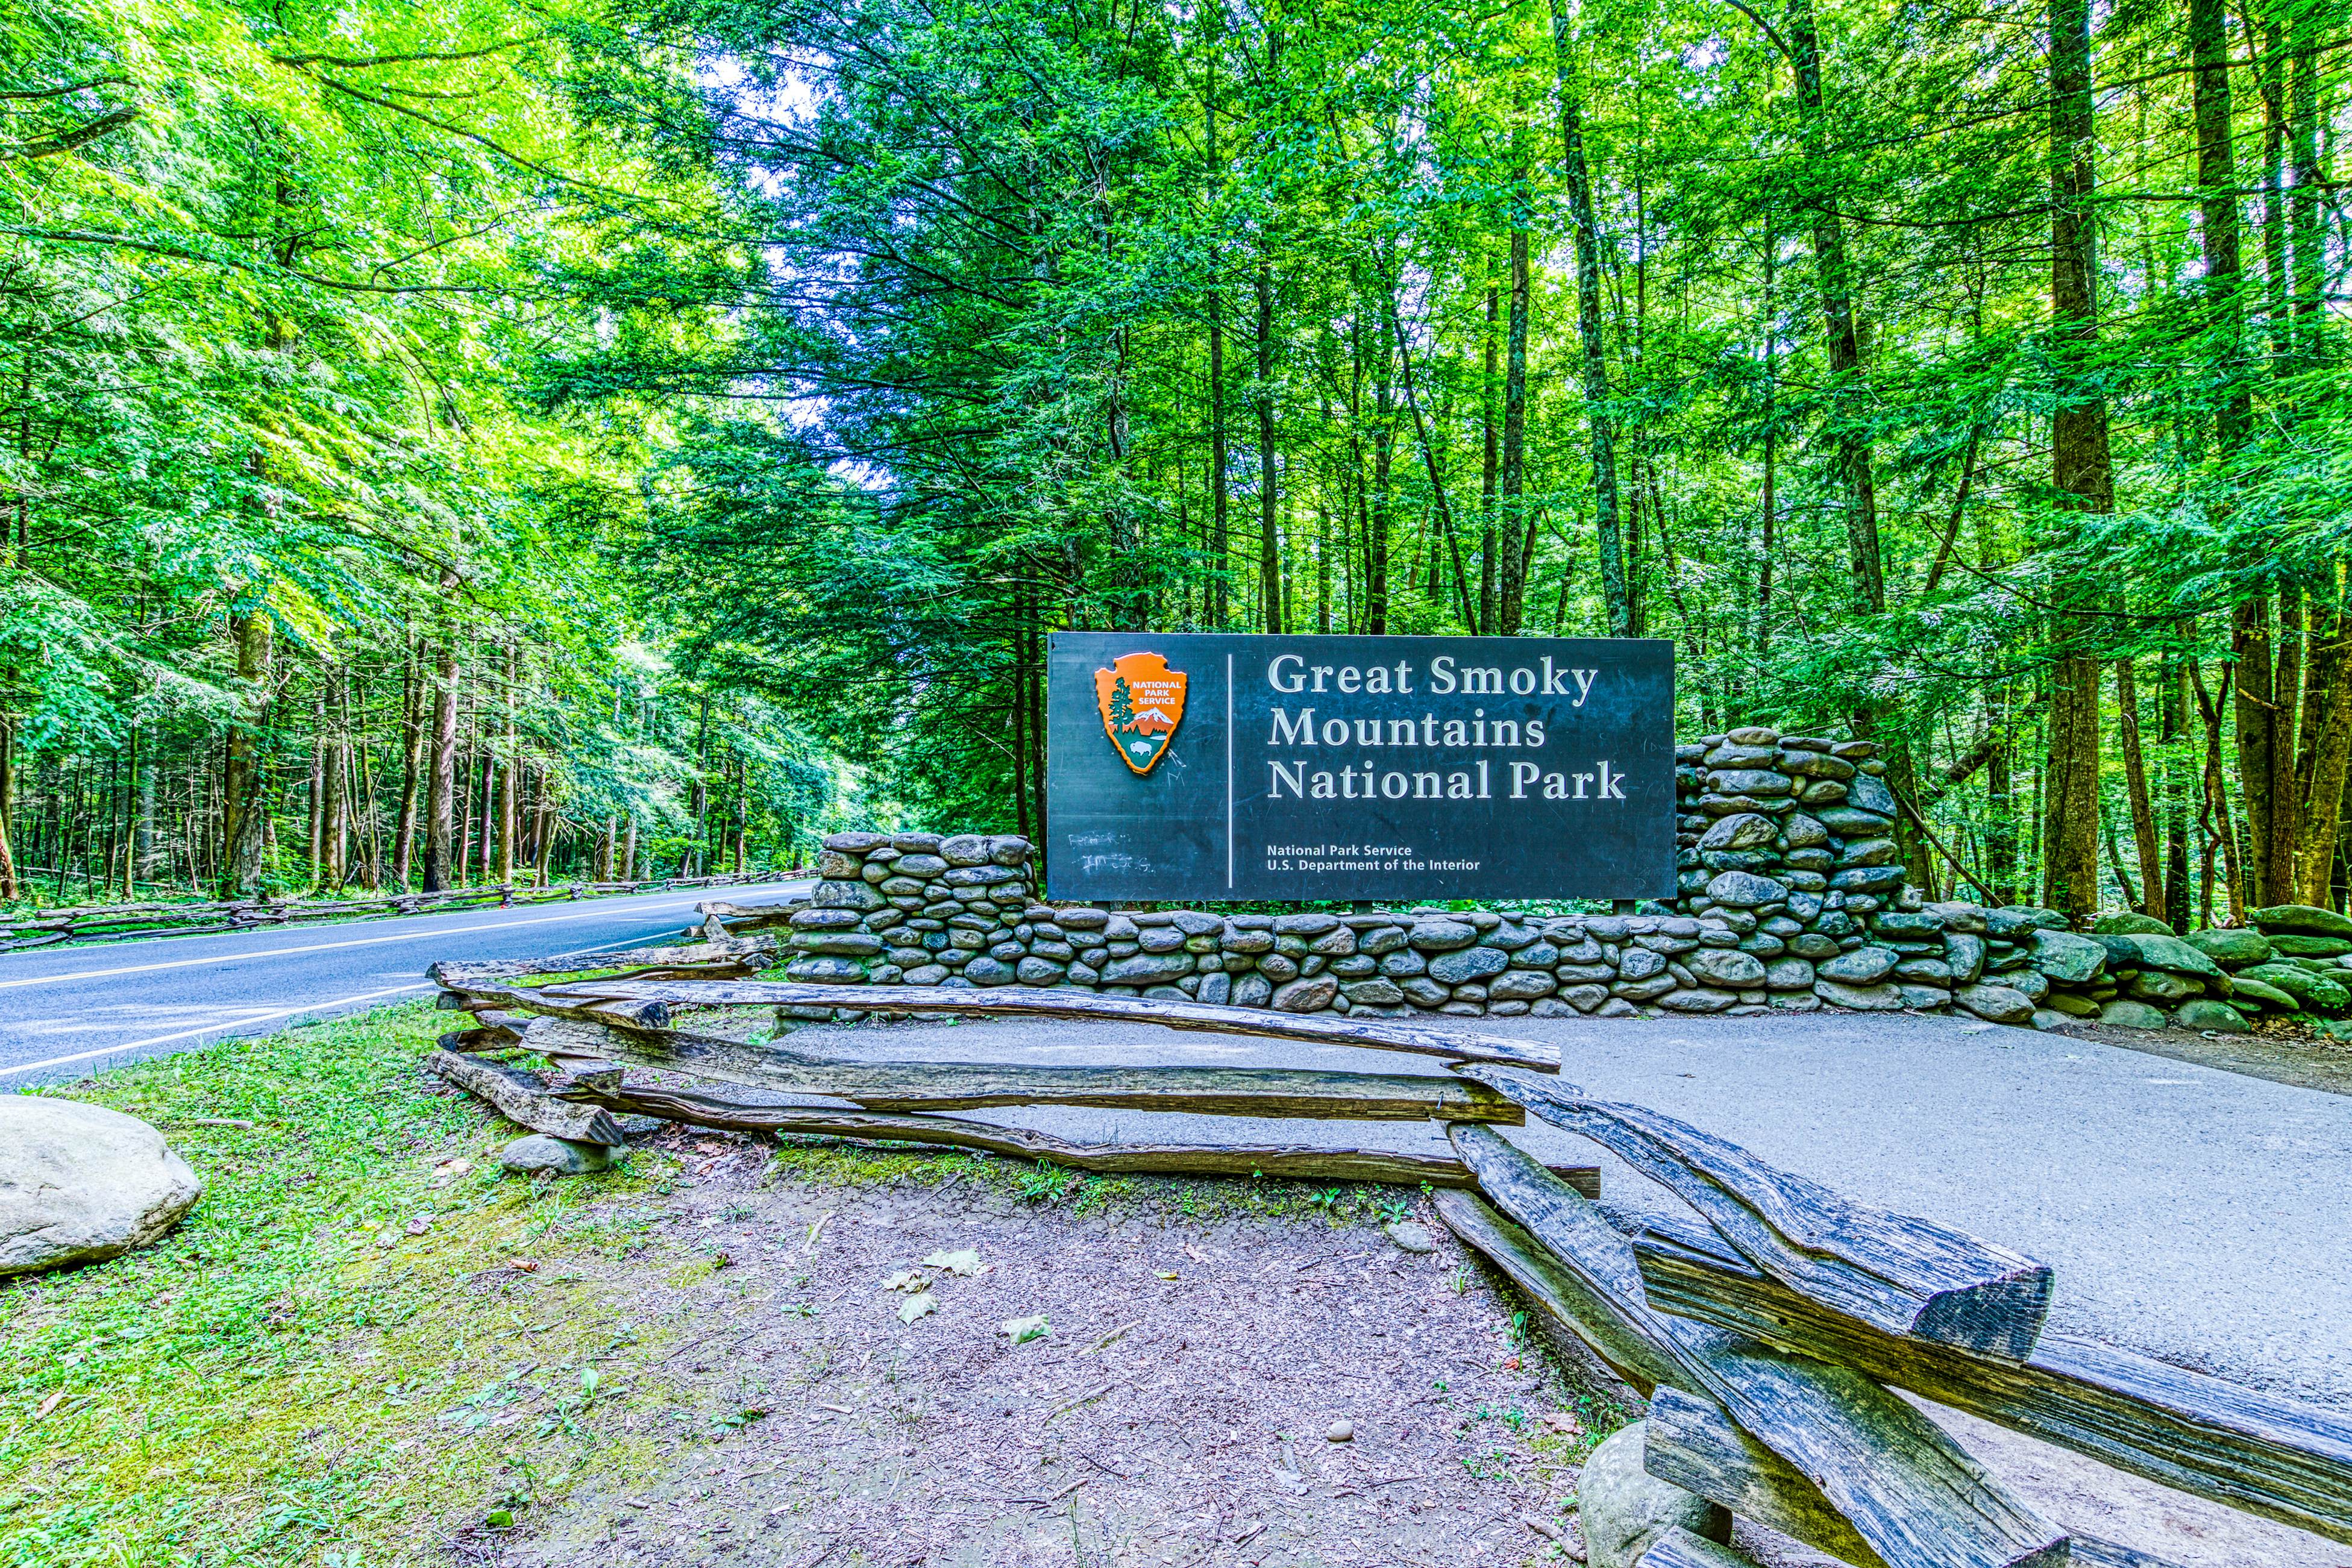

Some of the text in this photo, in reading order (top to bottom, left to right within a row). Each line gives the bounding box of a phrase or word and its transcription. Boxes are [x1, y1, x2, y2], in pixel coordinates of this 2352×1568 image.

[1267, 654, 1598, 707] Great Smoky
[1267, 707, 1546, 747] Mountains
[1267, 759, 1626, 799] National Park
[1267, 844, 1412, 856] National Park Service
[1267, 859, 1480, 873] U.S. Department of the Interior
